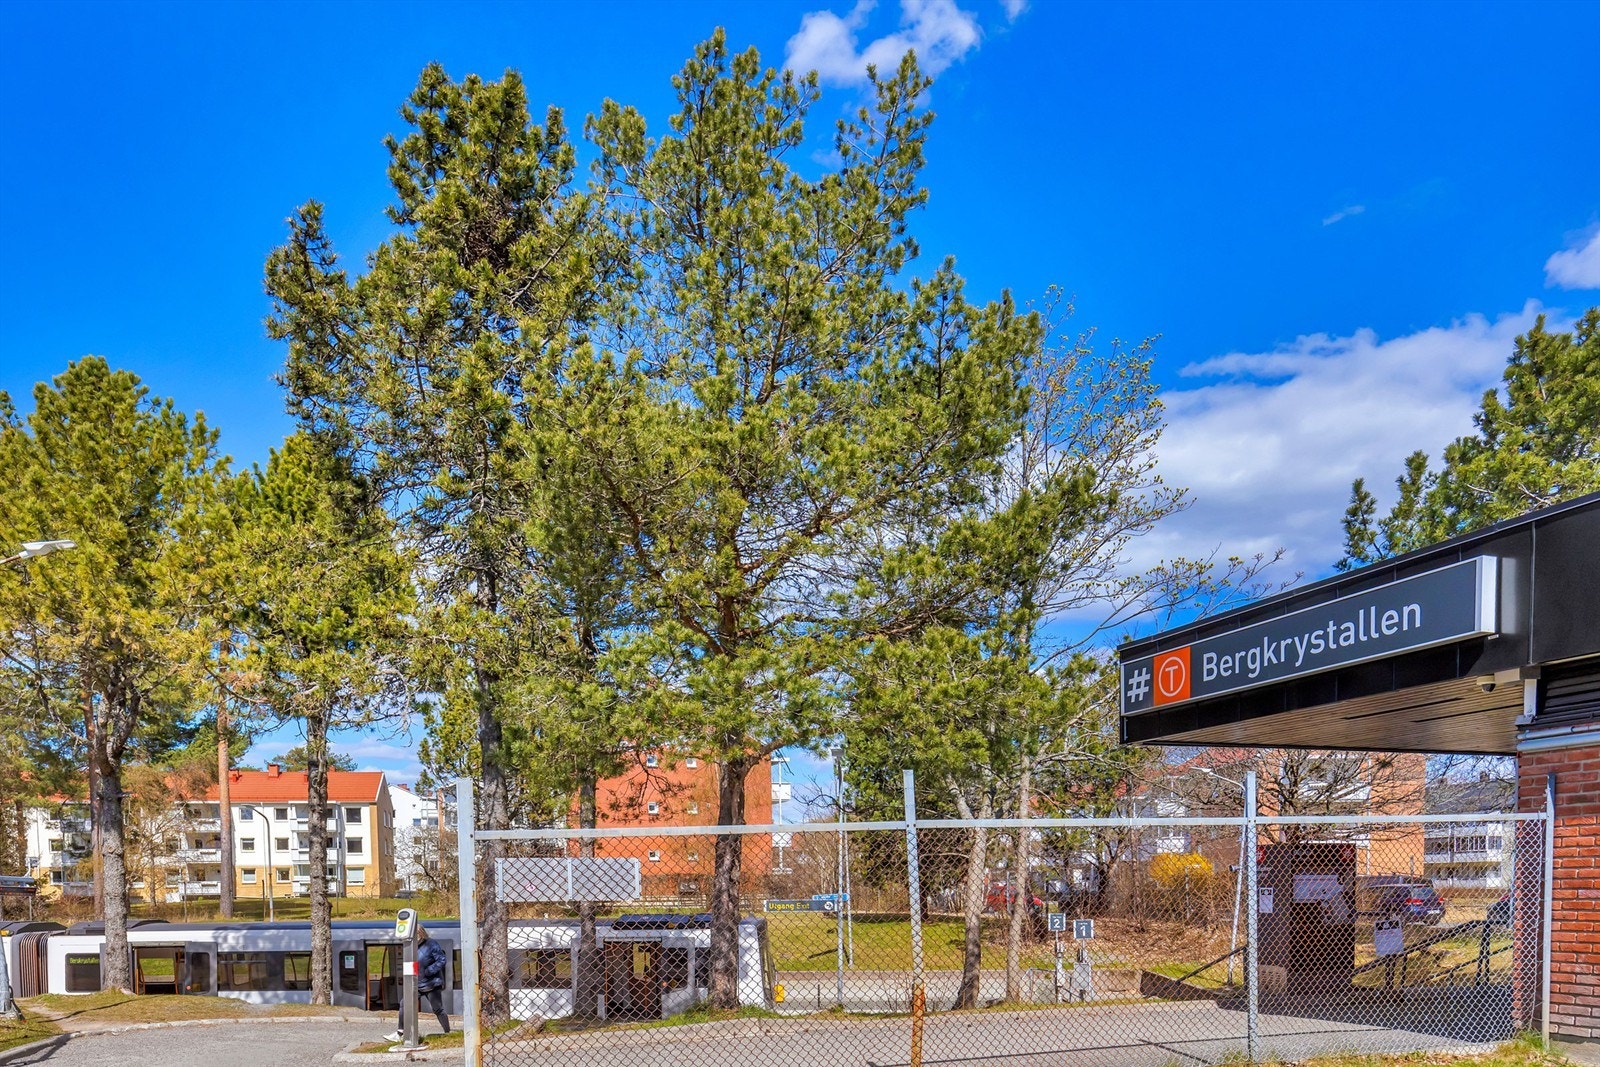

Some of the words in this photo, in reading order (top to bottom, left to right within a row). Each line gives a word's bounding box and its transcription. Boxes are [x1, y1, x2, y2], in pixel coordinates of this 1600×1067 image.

[1203, 603, 1421, 682] Bergkrystallen
[1054, 919, 1061, 928] 2
[1080, 925, 1086, 936] 1
